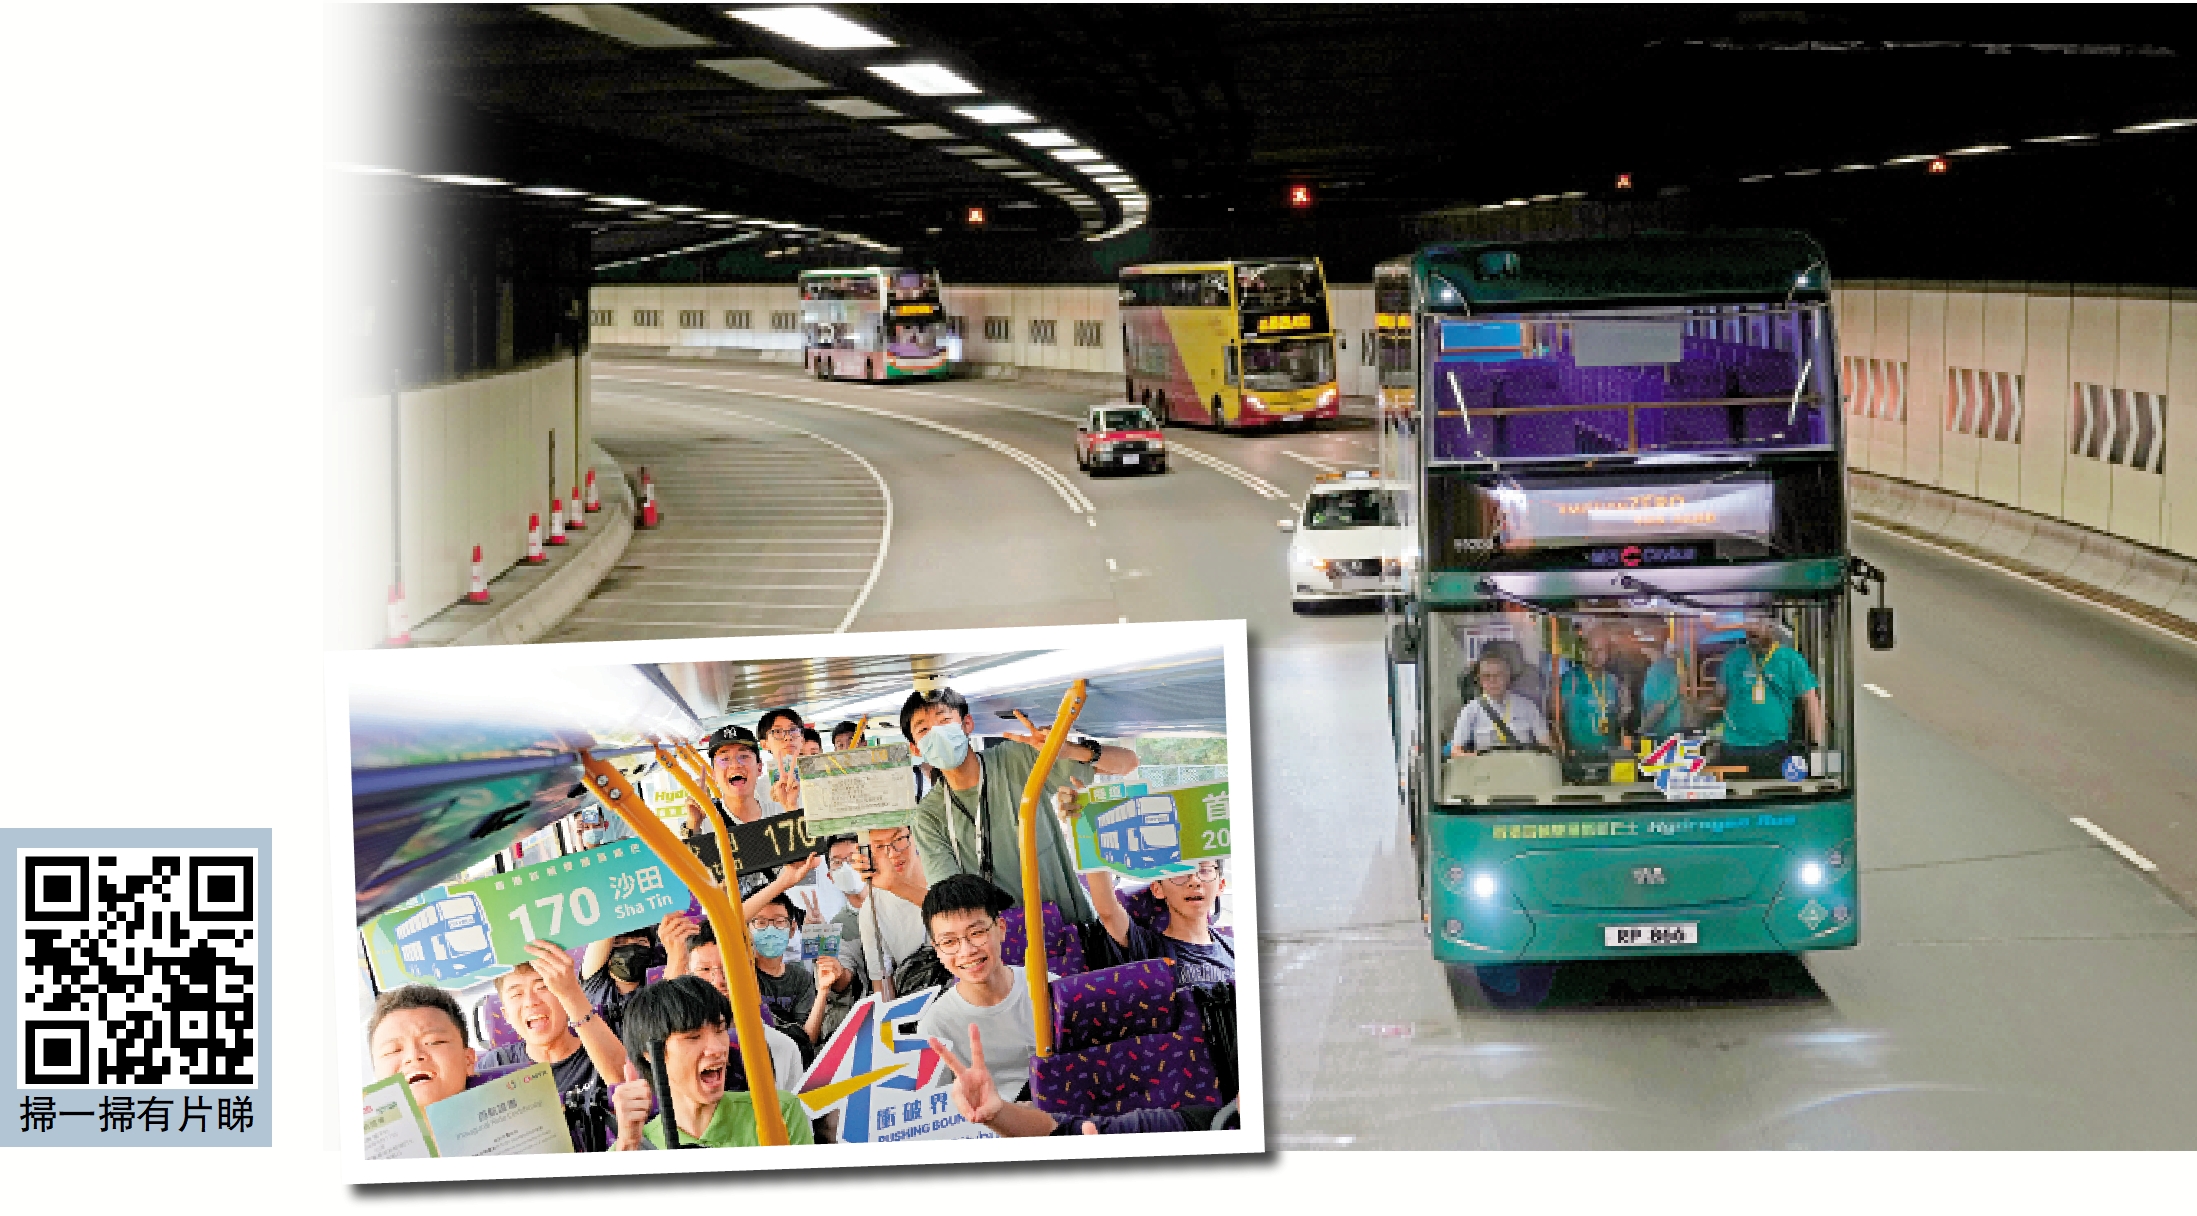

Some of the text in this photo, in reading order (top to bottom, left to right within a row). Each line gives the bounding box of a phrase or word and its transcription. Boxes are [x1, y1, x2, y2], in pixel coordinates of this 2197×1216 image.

[609, 865, 664, 903] 沙田
[508, 886, 602, 944] 170
[614, 892, 674, 920] Sha Tin
[876, 1090, 948, 1131] 衝破界
